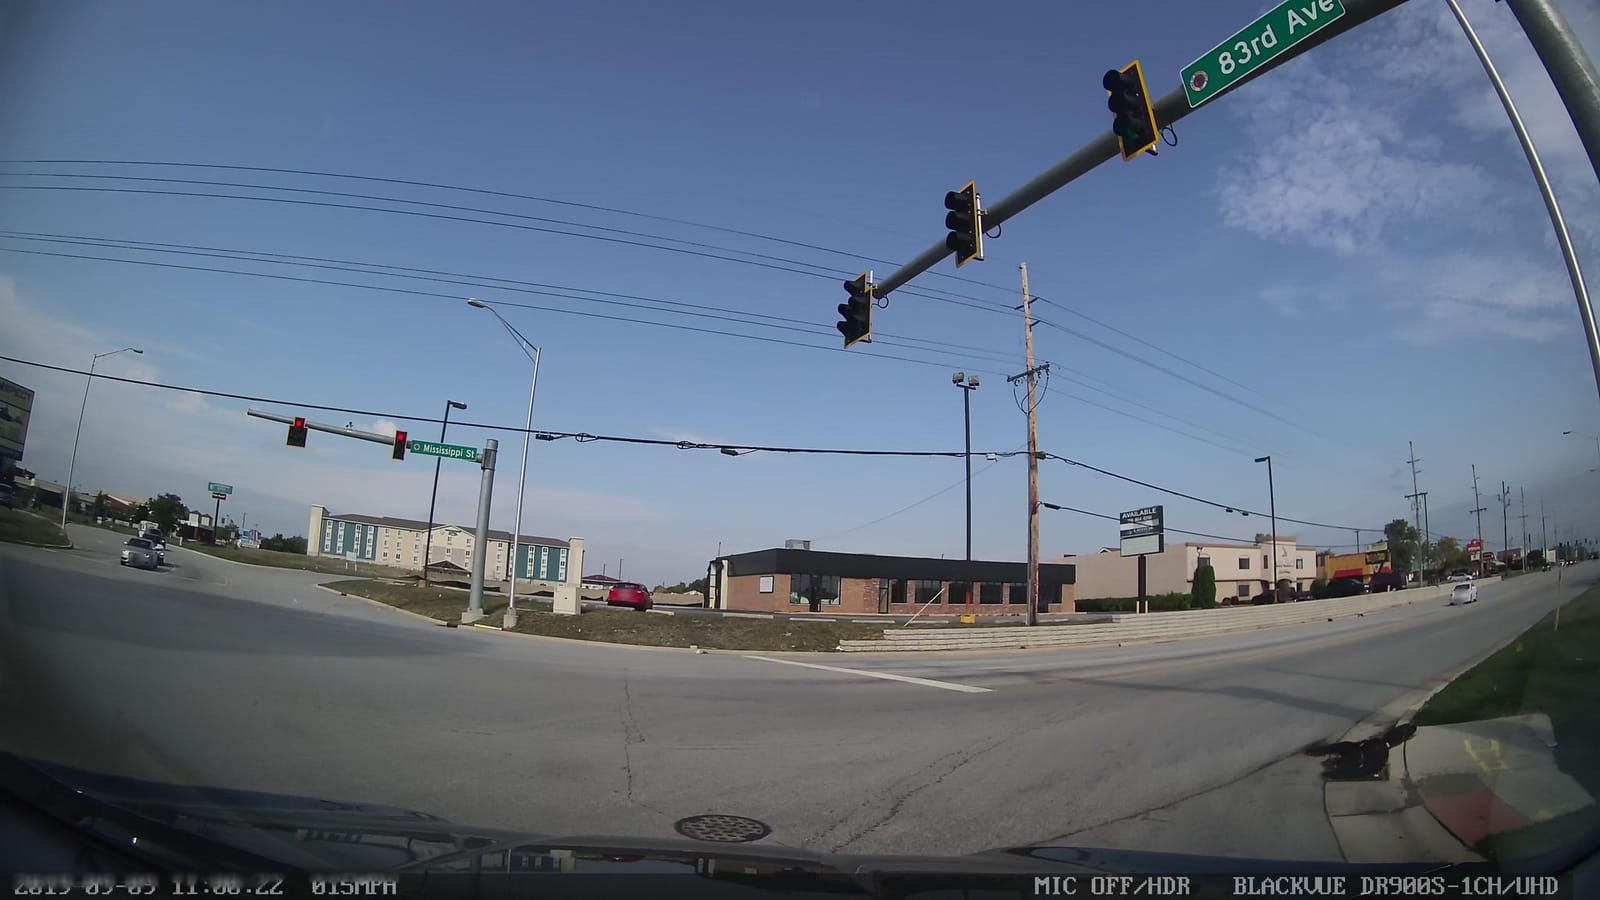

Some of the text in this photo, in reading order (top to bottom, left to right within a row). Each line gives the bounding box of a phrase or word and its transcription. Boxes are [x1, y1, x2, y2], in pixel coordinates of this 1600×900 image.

[1218, 0, 1334, 75] 83rd Ave
[423, 444, 475, 459] Mississippi St
[1122, 507, 1157, 519] AVAILABLE
